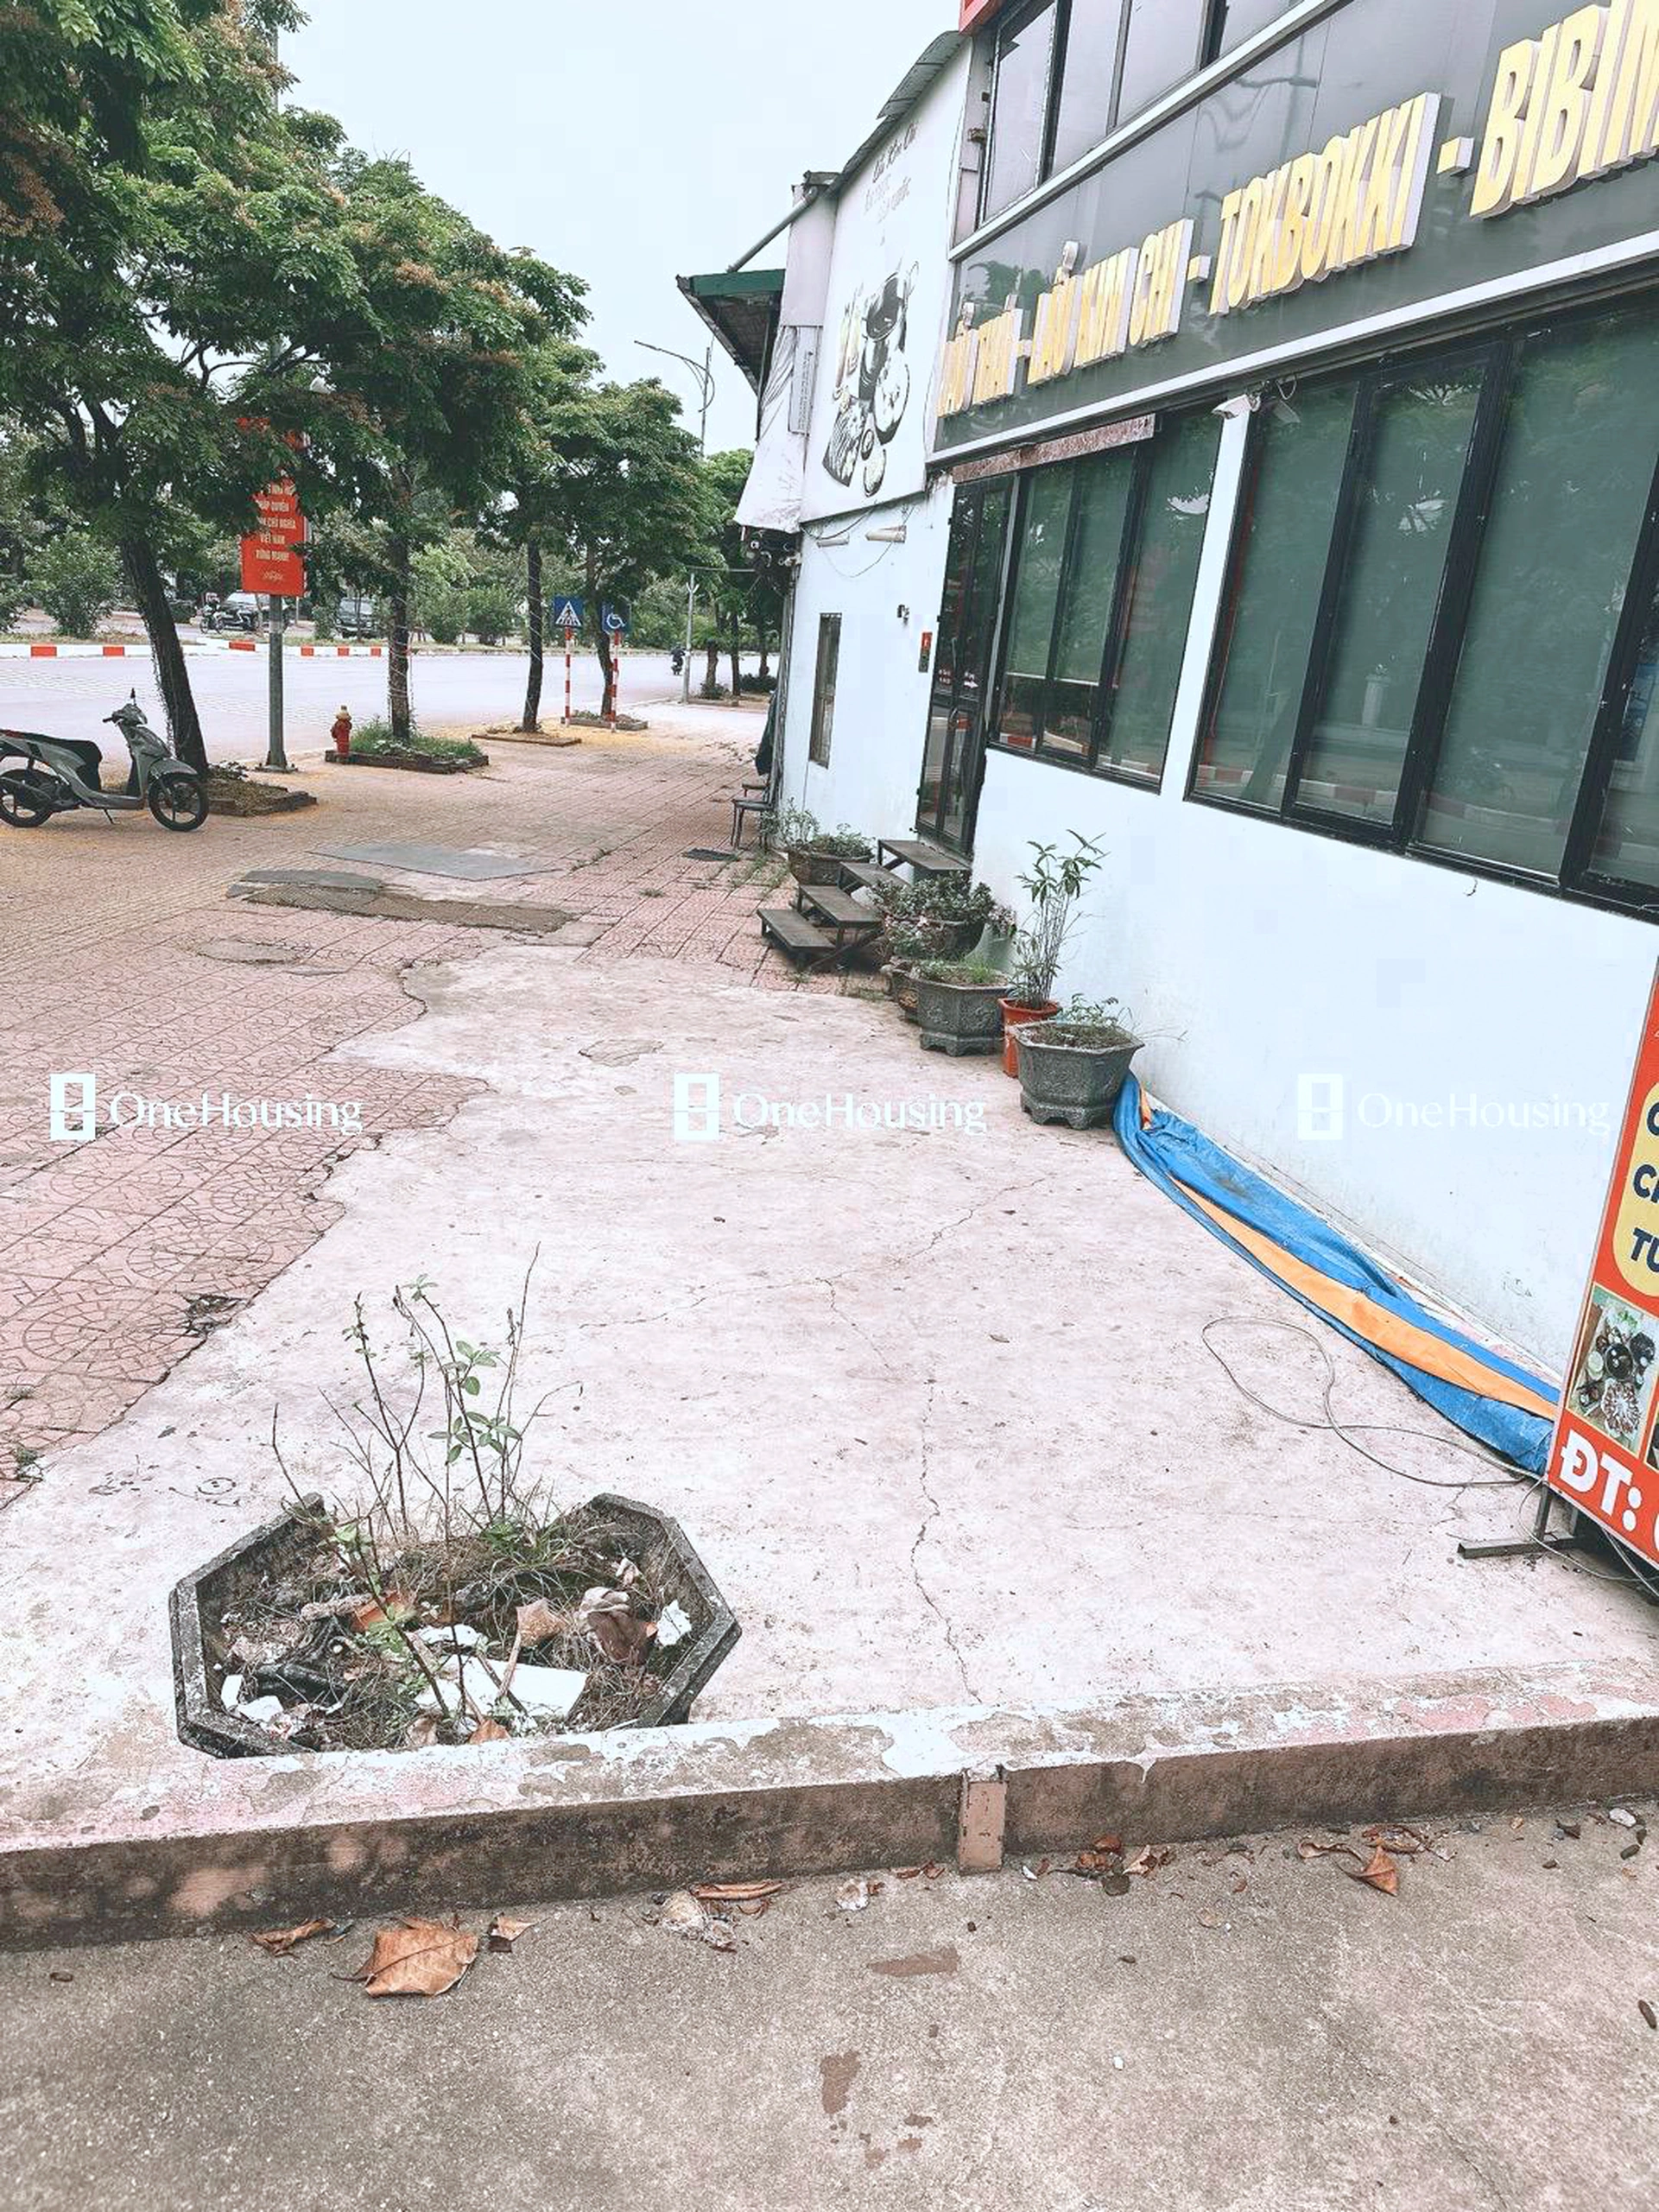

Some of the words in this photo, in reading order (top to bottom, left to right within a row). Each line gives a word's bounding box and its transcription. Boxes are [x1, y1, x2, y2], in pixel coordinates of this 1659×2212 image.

[1129, 218, 1194, 346] CHI
[1209, 92, 1441, 317] TOKBOKKI
[1560, 1429, 1642, 1531] ĐT:
